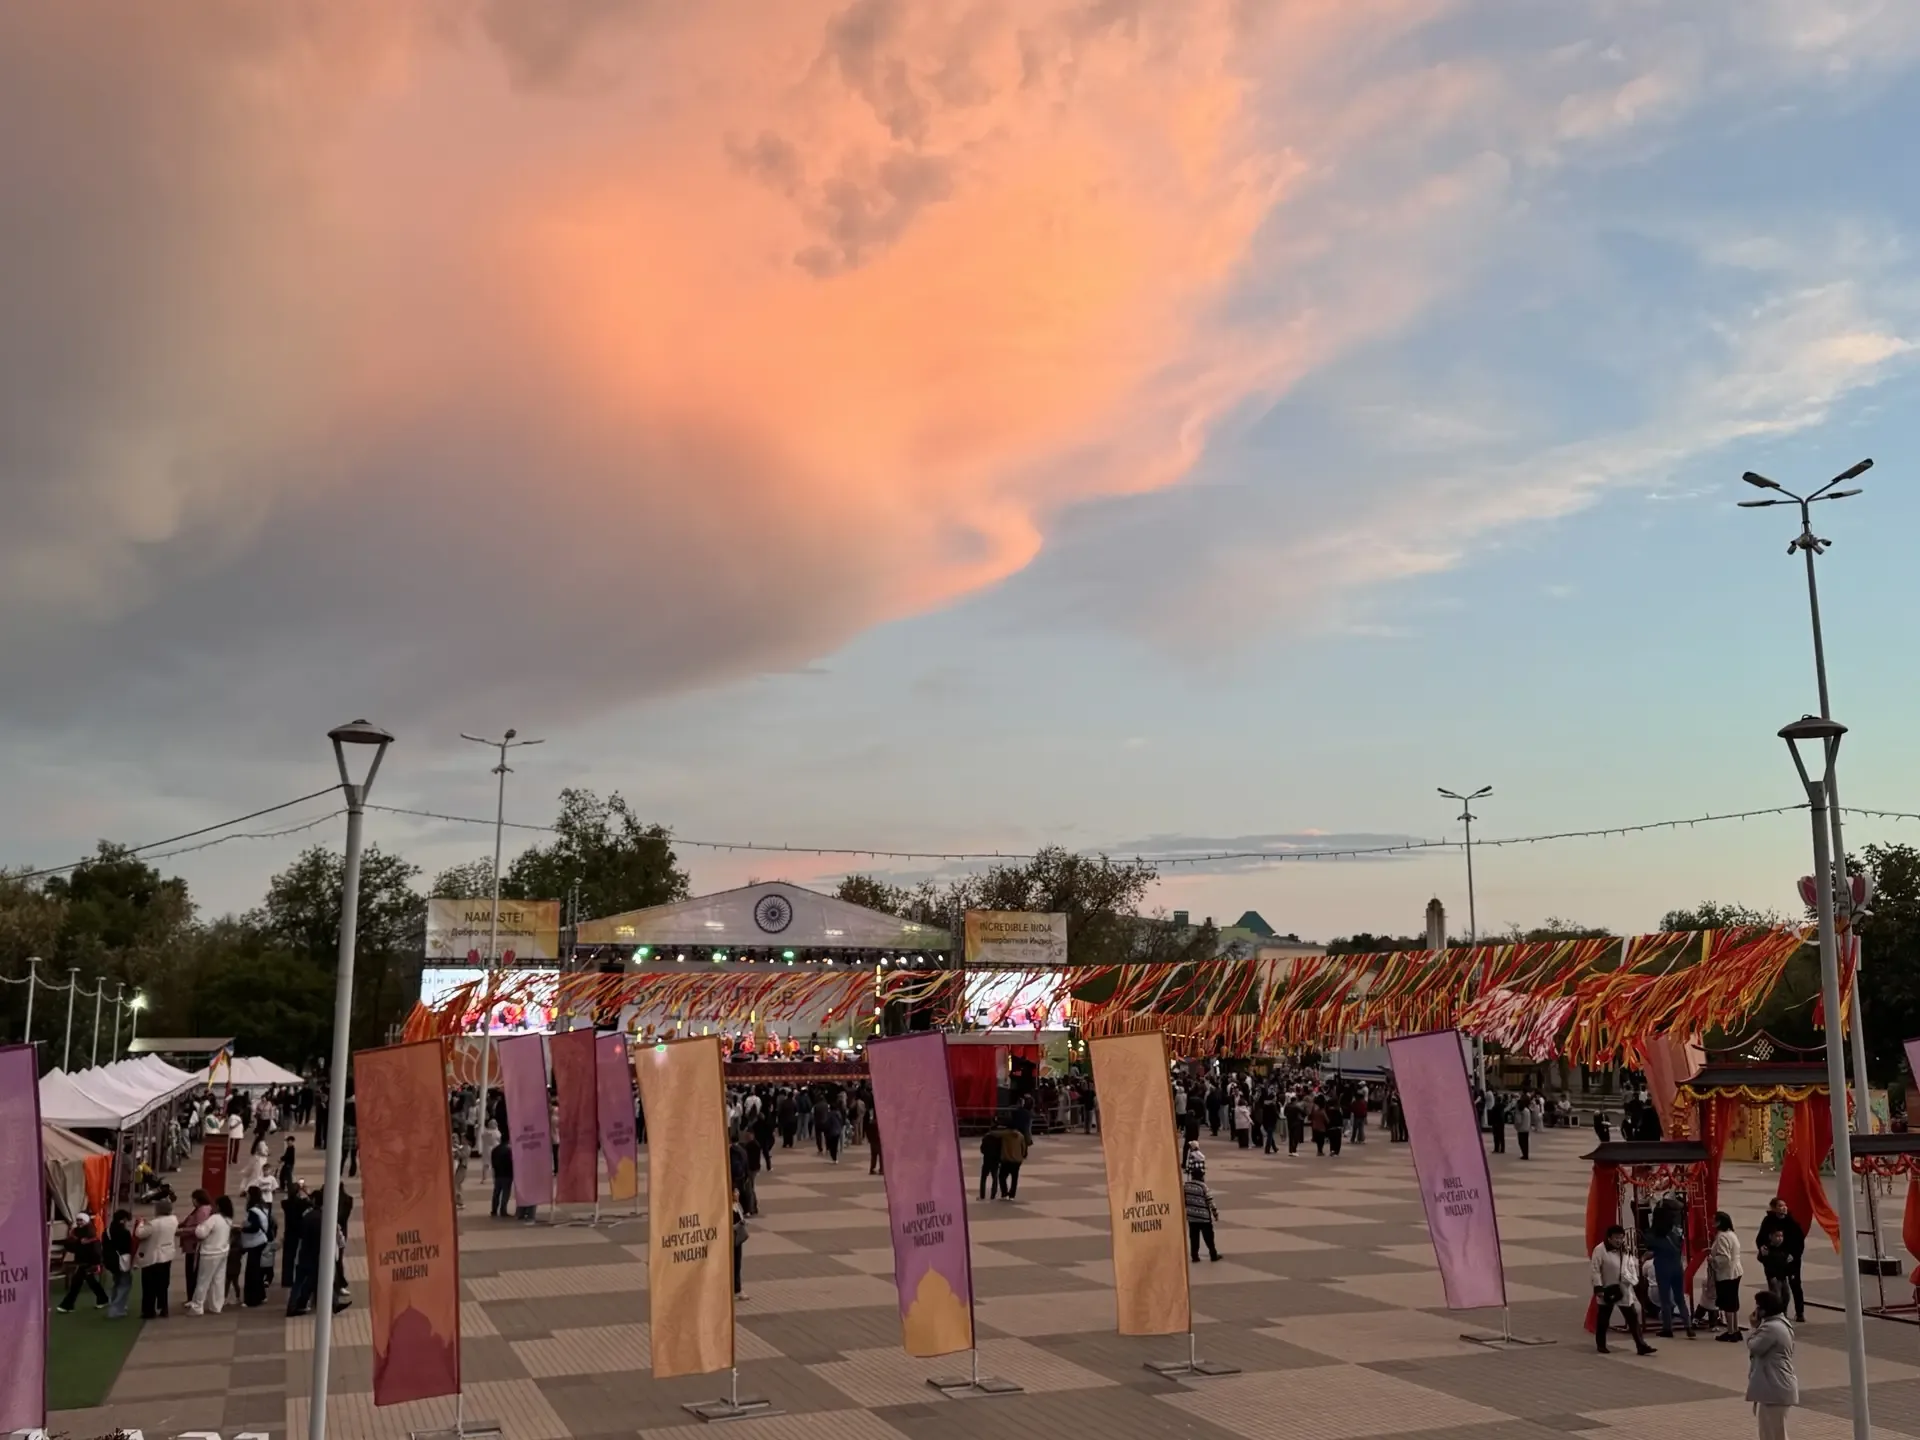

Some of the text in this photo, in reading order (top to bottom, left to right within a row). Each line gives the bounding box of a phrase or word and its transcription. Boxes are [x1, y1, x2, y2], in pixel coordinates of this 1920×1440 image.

[465, 911, 525, 923] NAMSTE!
[980, 922, 1053, 933] INCREDIBLE INDIA
